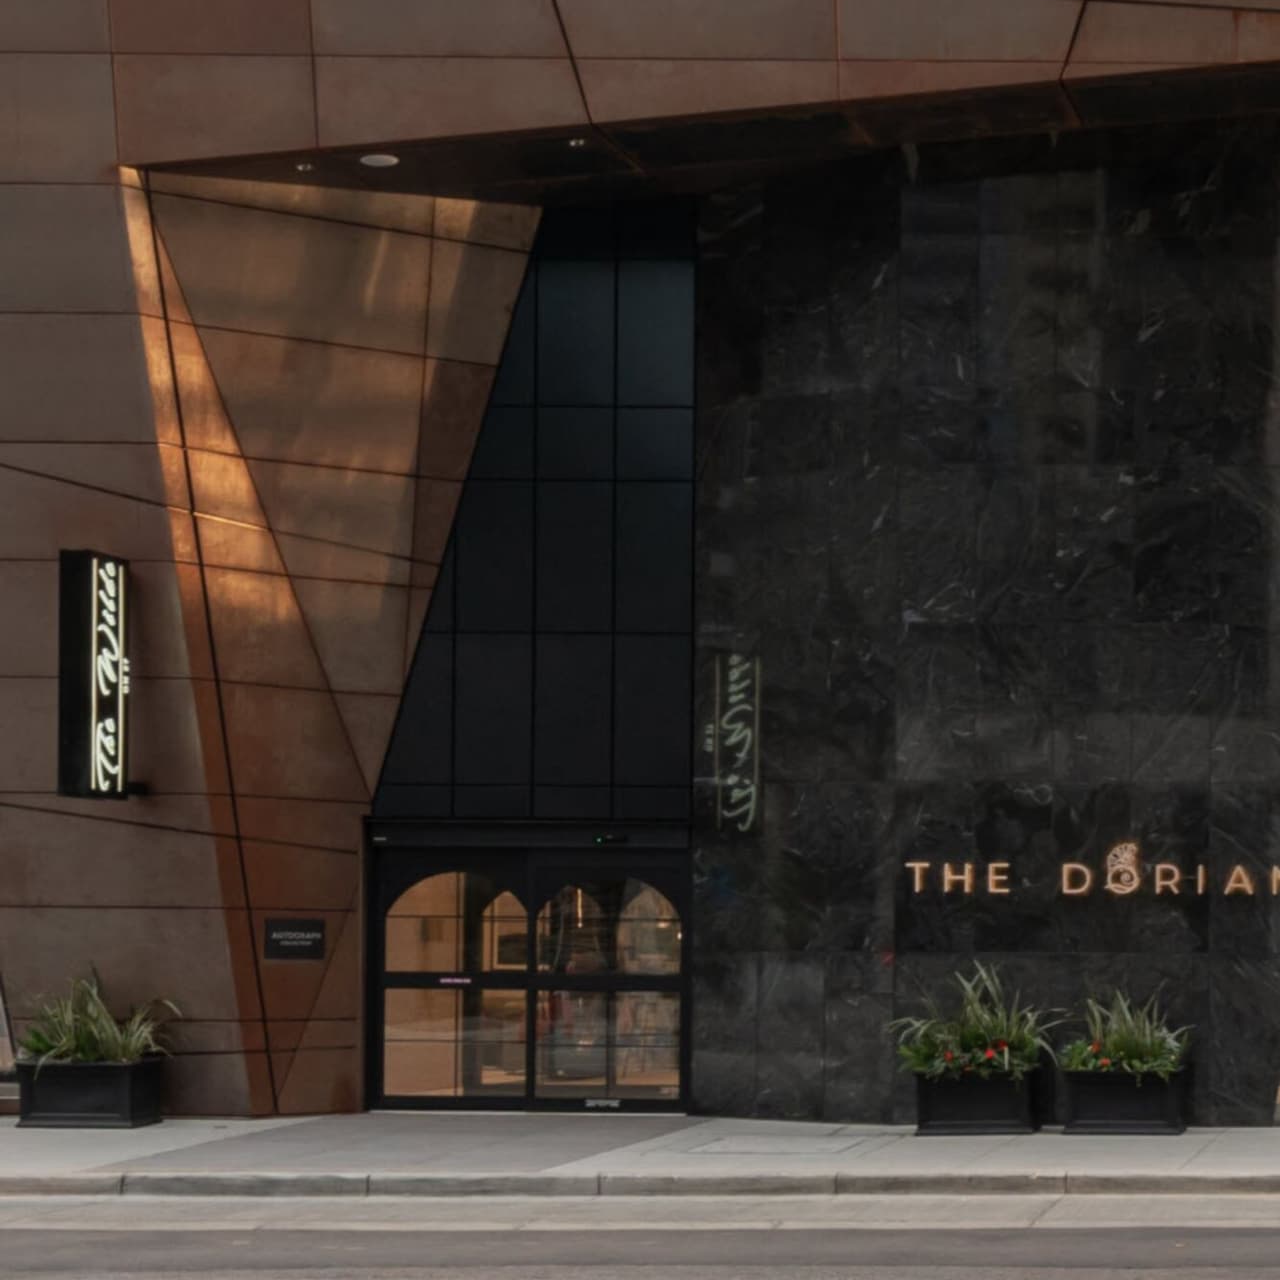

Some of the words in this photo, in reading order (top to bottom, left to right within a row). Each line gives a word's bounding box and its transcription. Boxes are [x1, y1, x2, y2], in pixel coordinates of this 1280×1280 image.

[97, 562, 119, 695] Wilde
[96, 718, 119, 791] The
[905, 861, 1010, 894] THE
